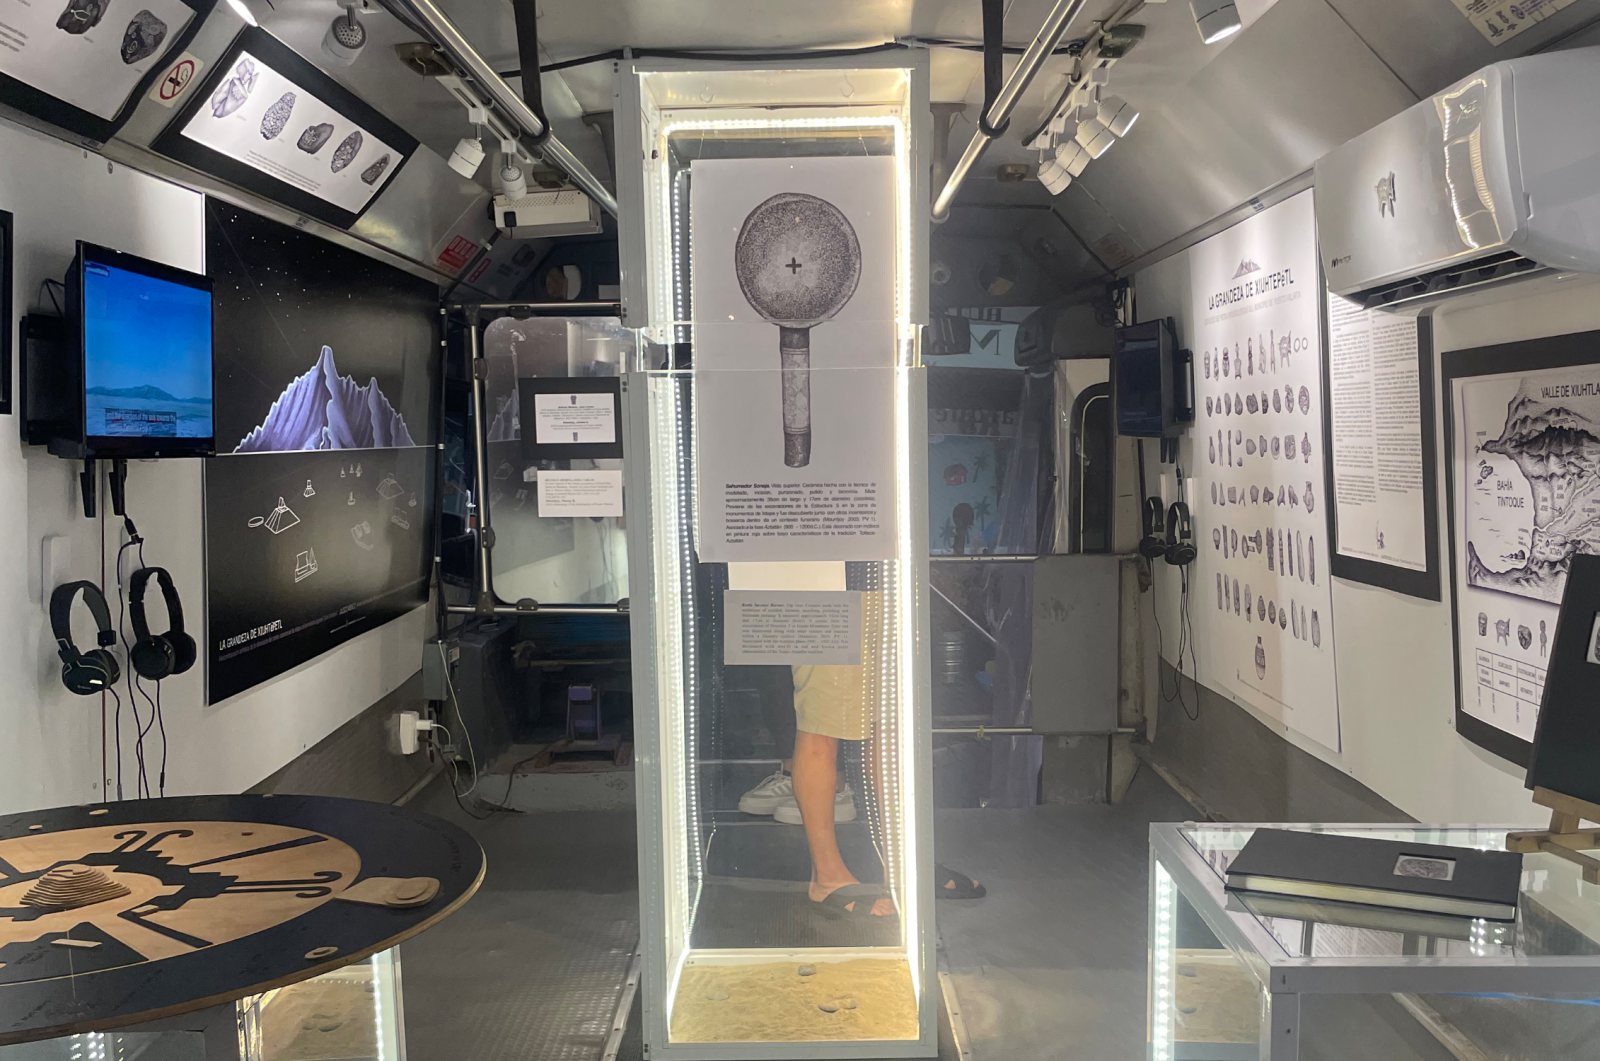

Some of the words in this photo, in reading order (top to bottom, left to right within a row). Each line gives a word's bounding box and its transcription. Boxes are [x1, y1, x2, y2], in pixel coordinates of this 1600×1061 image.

[1208, 295, 1215, 310] LA
[1215, 285, 1244, 308] GRANDEZA
[1245, 281, 1253, 298] DE
[1540, 386, 1560, 398] VALLE
[1561, 384, 1569, 398] DE
[1497, 496, 1524, 508] TINTOQUE
[219, 639, 226, 650] LA
[227, 631, 250, 648] GRANDEZA
[250, 628, 257, 640] DE
